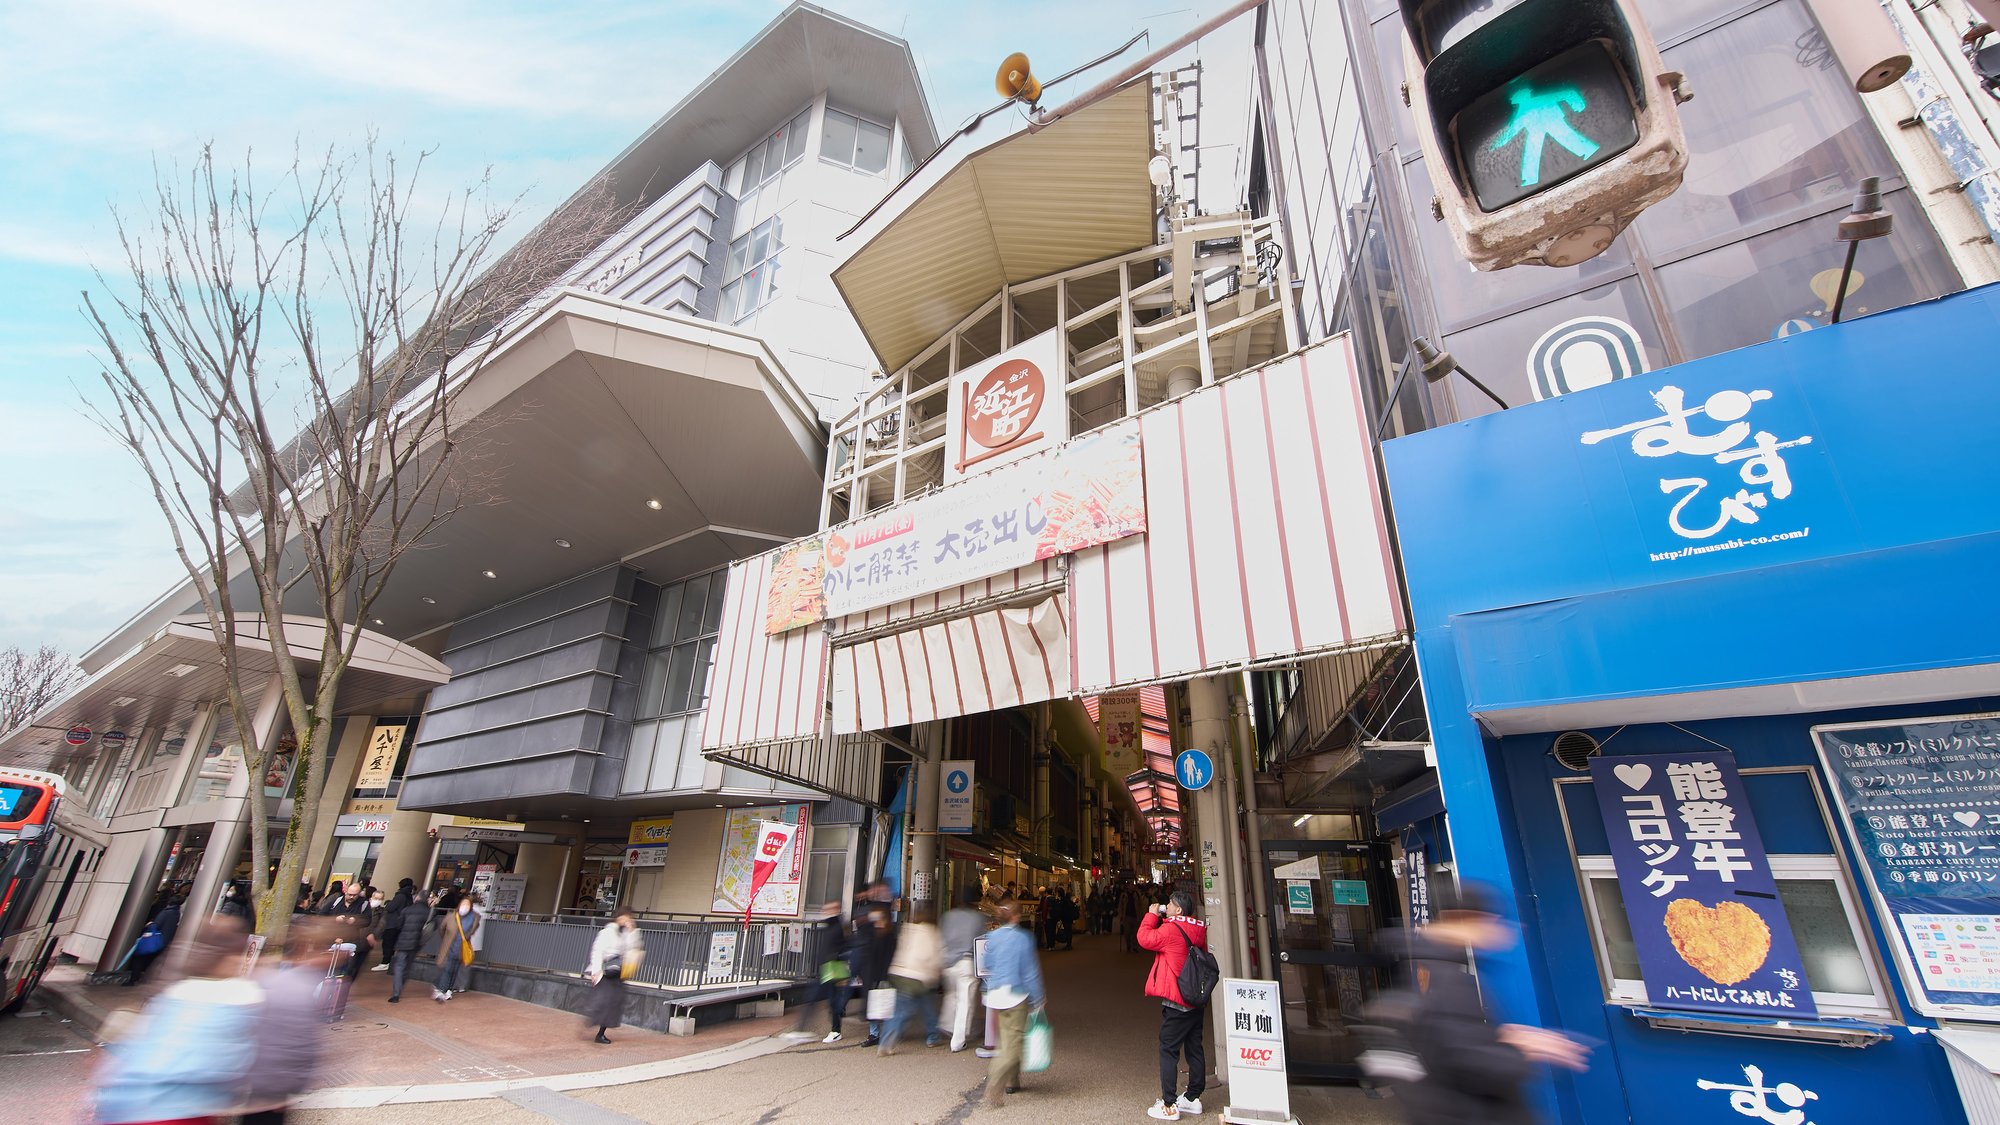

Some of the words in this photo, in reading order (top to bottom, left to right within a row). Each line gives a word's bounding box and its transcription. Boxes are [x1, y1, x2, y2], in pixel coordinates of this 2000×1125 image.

[1009, 368, 1029, 384] 金沢
[822, 540, 921, 596] かに解禁
[933, 501, 1048, 565] 大売出し
[1649, 527, 1810, 562] http://musubi-co.com/
[369, 729, 393, 771] 八千屋
[1844, 756, 1909, 769] Vanilla-flavored
[1910, 755, 1926, 765] soft
[1927, 754, 1940, 764] ice
[1941, 753, 1966, 764] cream
[1968, 751, 1988, 761] with
[1857, 787, 1933, 798] Vanilla-flavored
[1935, 786, 1954, 794] soft
[1956, 785, 1970, 793] ice
[1665, 762, 1753, 883] 能登牛
[1875, 831, 1905, 839] Noto
[1909, 830, 1936, 838] beef
[1622, 794, 1689, 898] コロッケ
[1886, 858, 1943, 866] Kanazawa
[1946, 857, 1975, 866] curry
[1236, 988, 1267, 1001] 喫茶室
[1666, 985, 1796, 1008] ハートにしてみました
